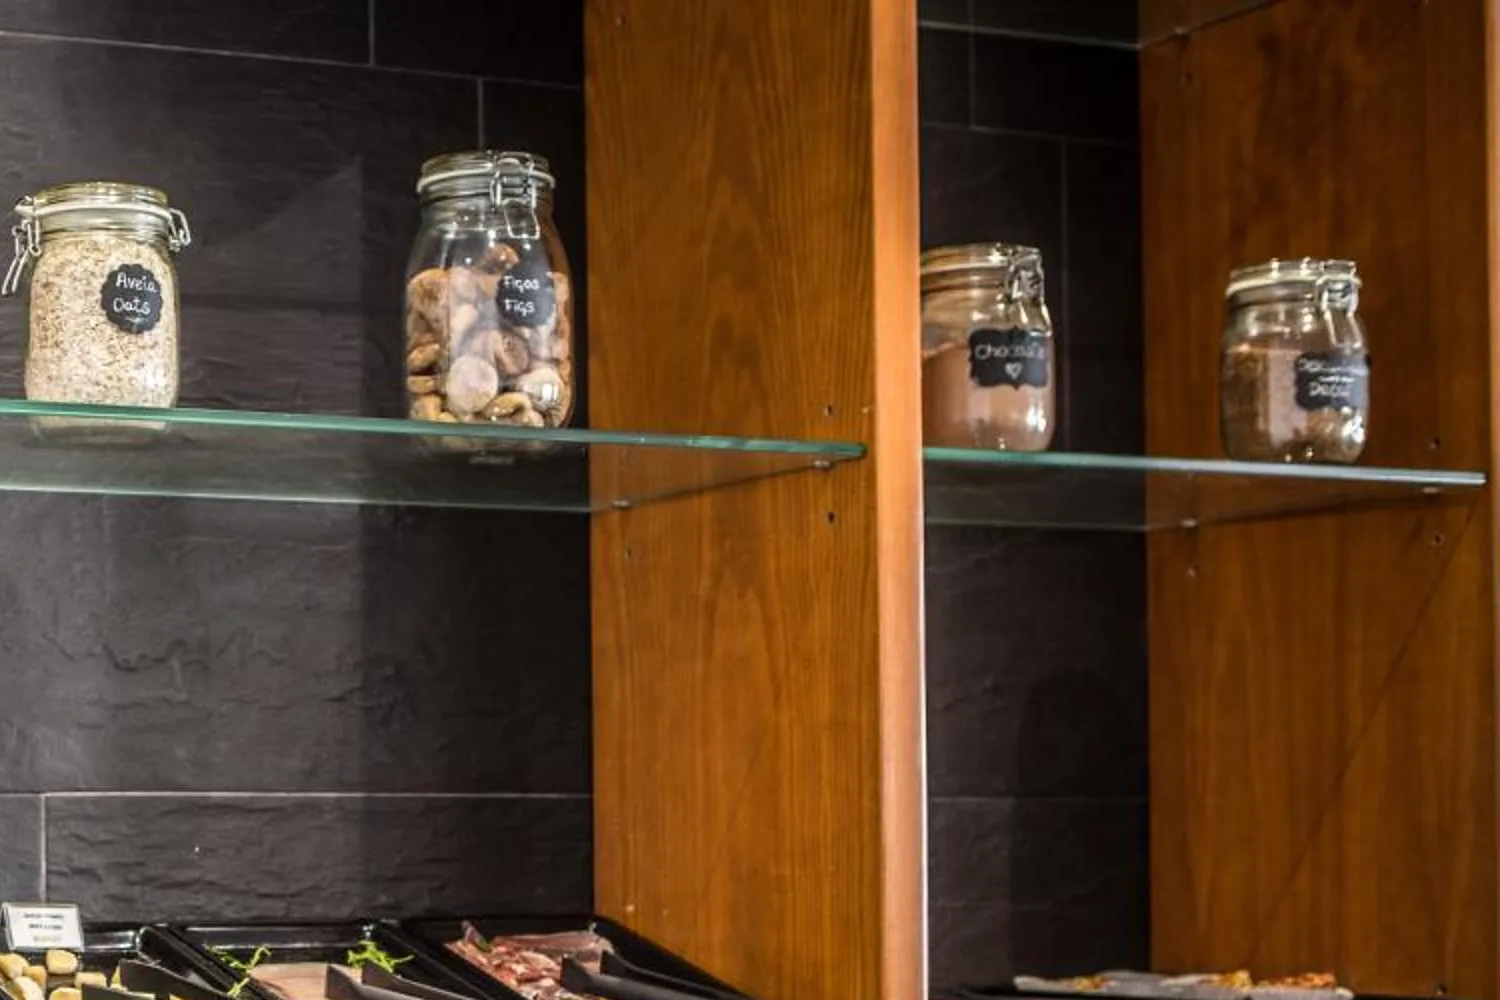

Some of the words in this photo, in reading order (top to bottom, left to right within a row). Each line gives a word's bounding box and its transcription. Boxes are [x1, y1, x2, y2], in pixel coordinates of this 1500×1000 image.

[115, 272, 157, 293] Aveia
[503, 275, 540, 293] Figos
[113, 296, 150, 315] Oats
[504, 298, 535, 317] Figs
